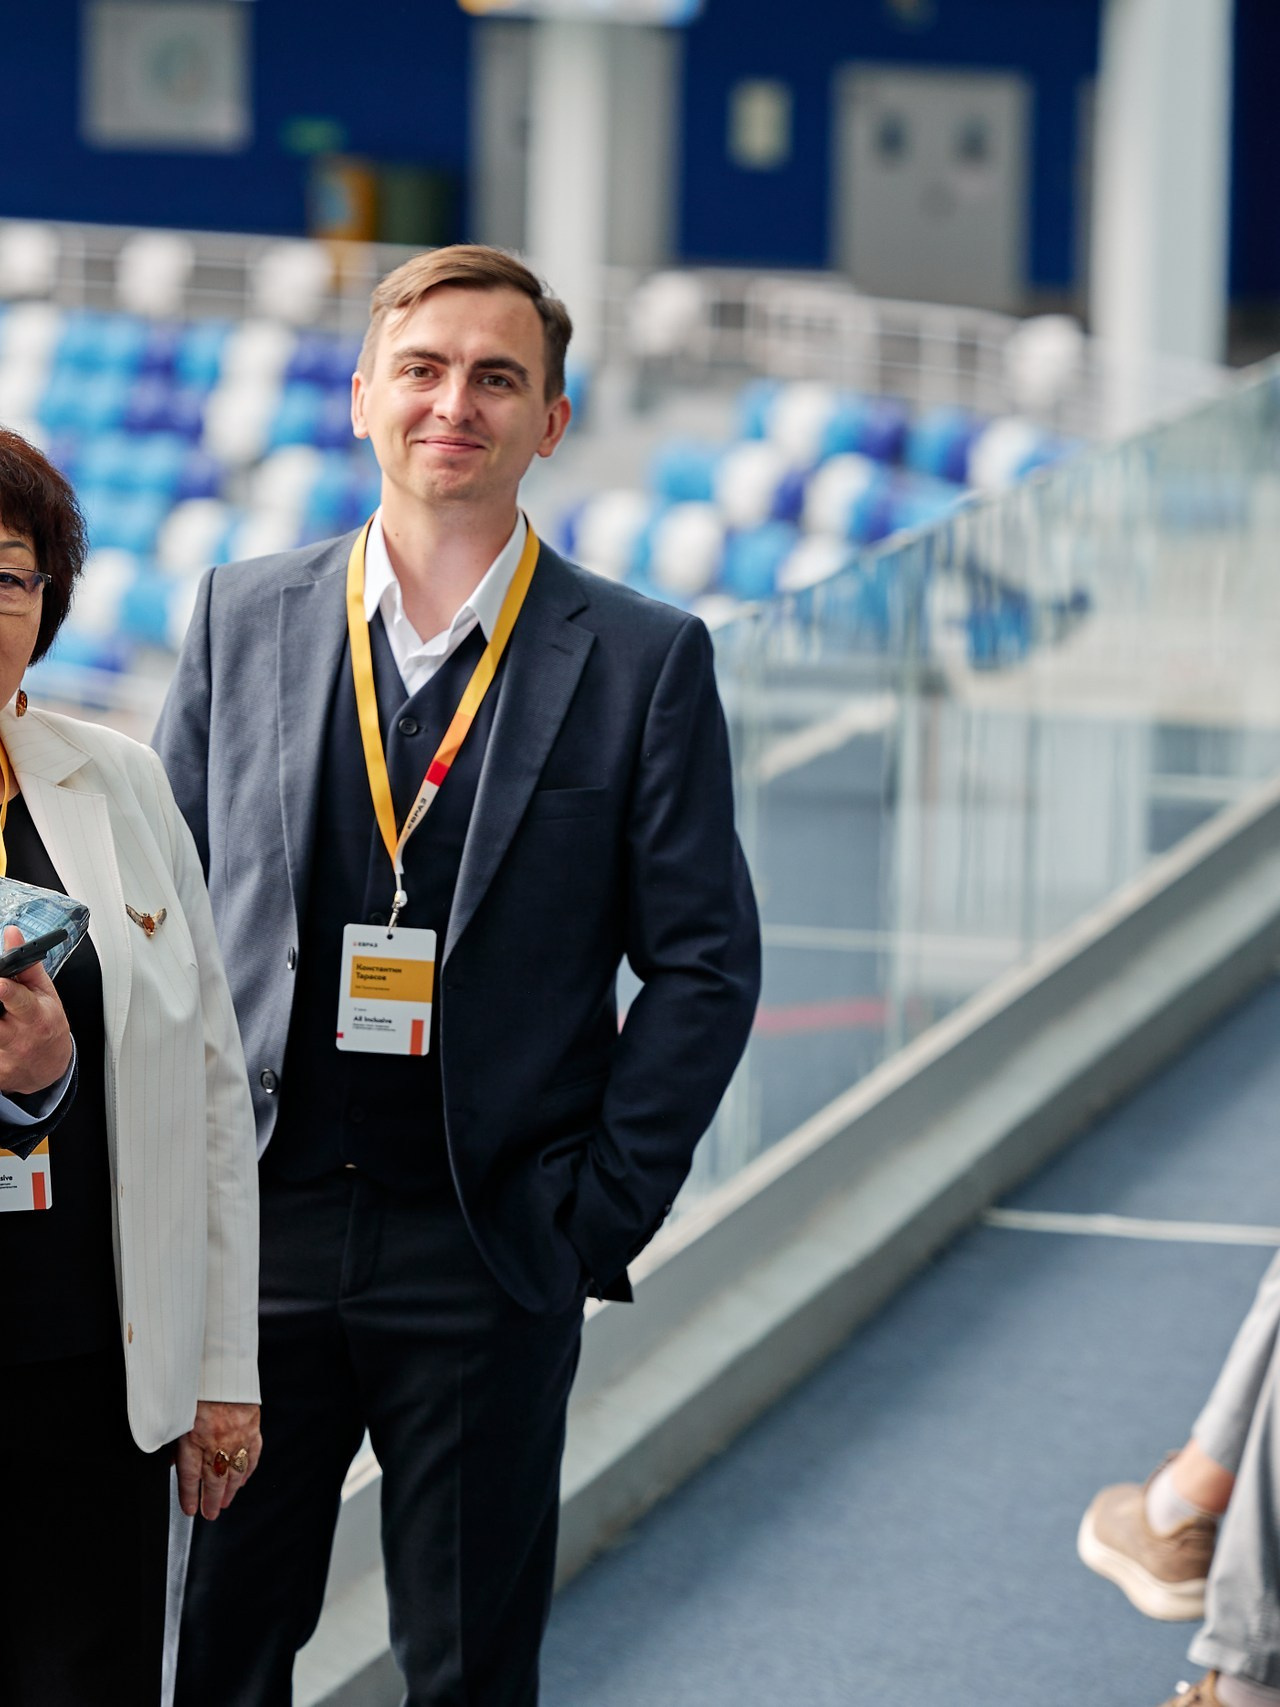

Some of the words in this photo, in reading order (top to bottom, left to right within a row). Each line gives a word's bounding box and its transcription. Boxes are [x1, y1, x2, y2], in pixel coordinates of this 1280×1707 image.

[407, 797, 426, 829] ЕВРАЗ
[356, 964, 402, 973] Константин
[356, 972, 387, 980] Тарасов
